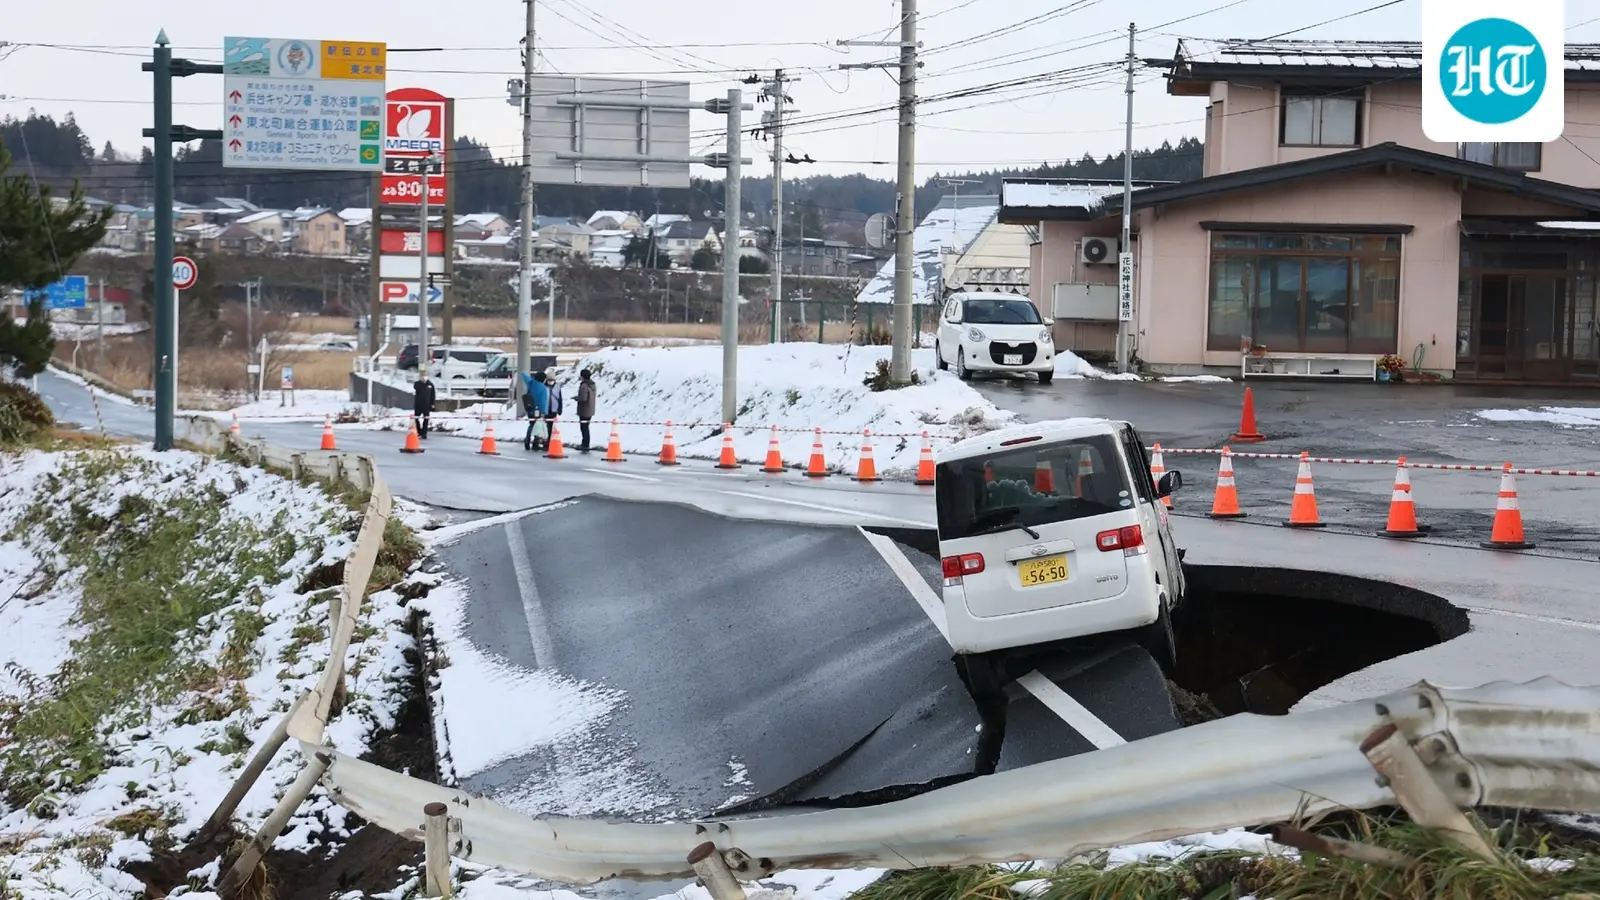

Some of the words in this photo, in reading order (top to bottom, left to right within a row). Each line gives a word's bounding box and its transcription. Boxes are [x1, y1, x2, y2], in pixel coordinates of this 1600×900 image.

[403, 232, 422, 251] 酒
[172, 266, 189, 280] 40
[383, 283, 408, 303] P
[1030, 565, 1066, 583] 56-50
